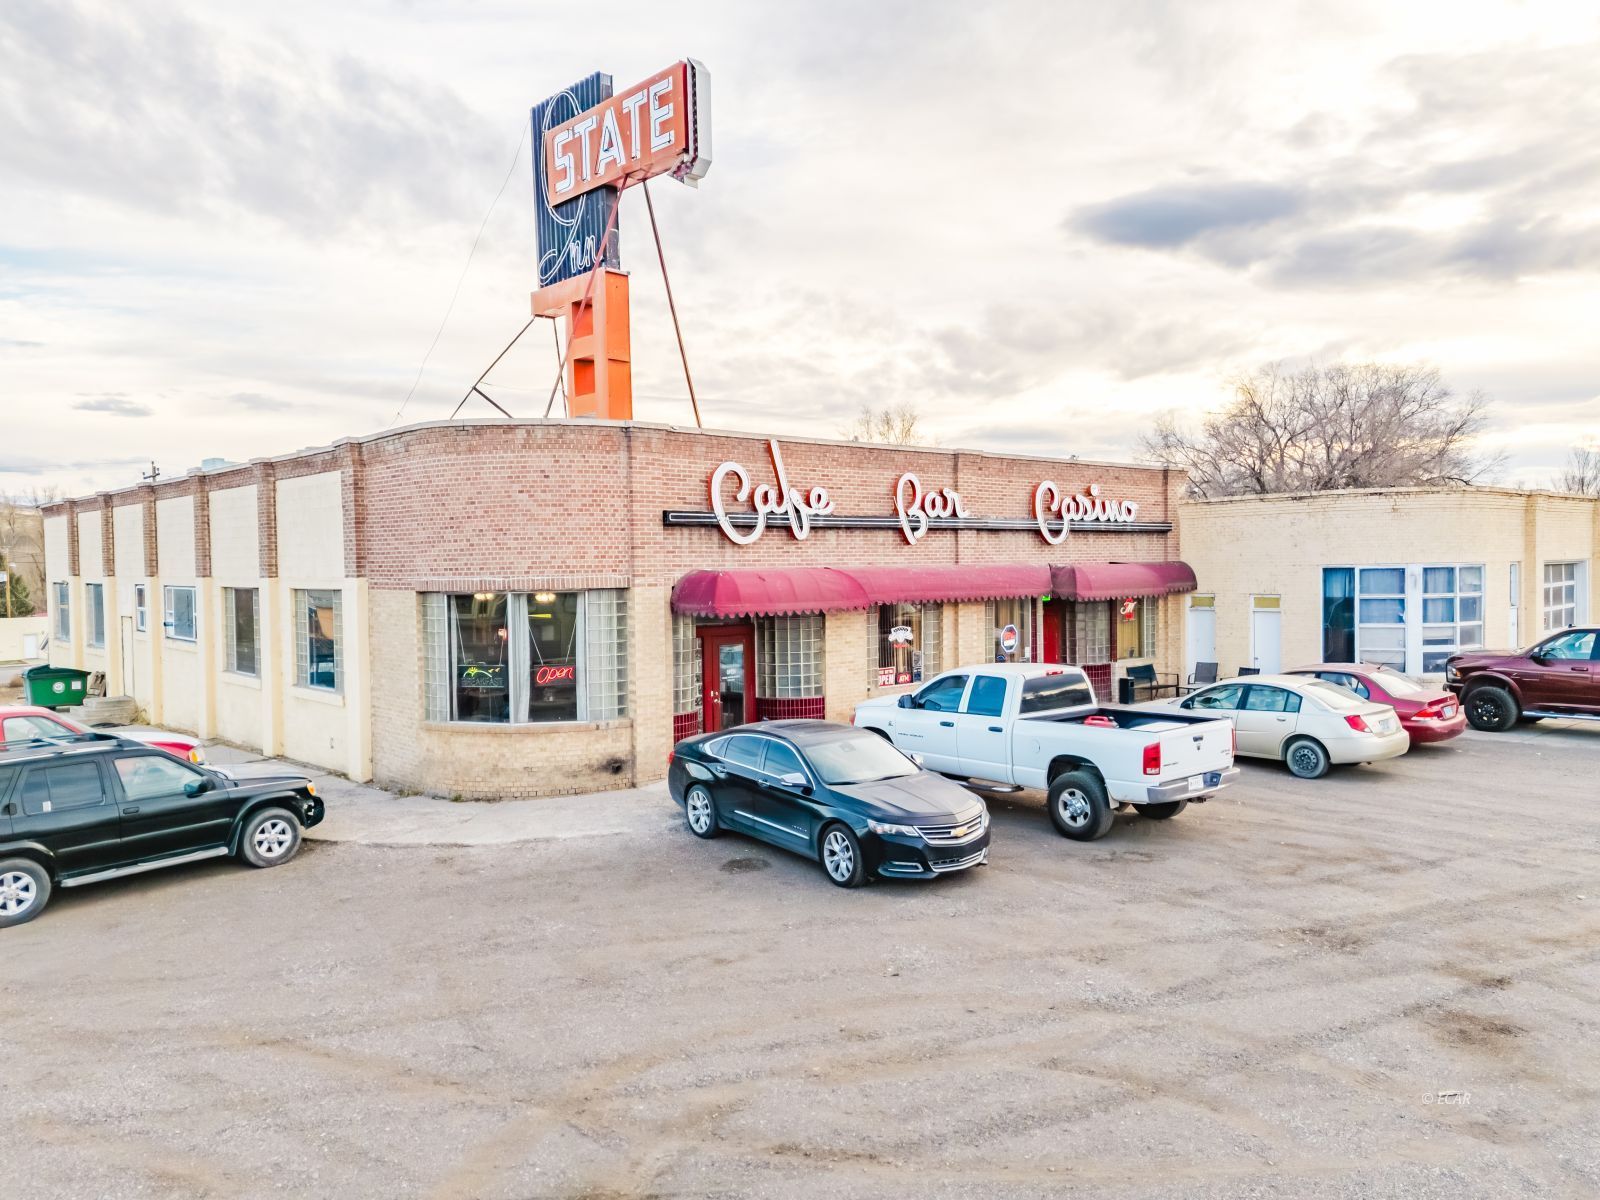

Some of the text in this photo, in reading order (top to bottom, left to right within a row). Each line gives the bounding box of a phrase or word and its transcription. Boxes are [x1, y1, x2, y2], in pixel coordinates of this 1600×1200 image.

[552, 75, 675, 194] STATE
[708, 438, 1138, 545] Cafe Bar Casino
[537, 666, 574, 683] Open
